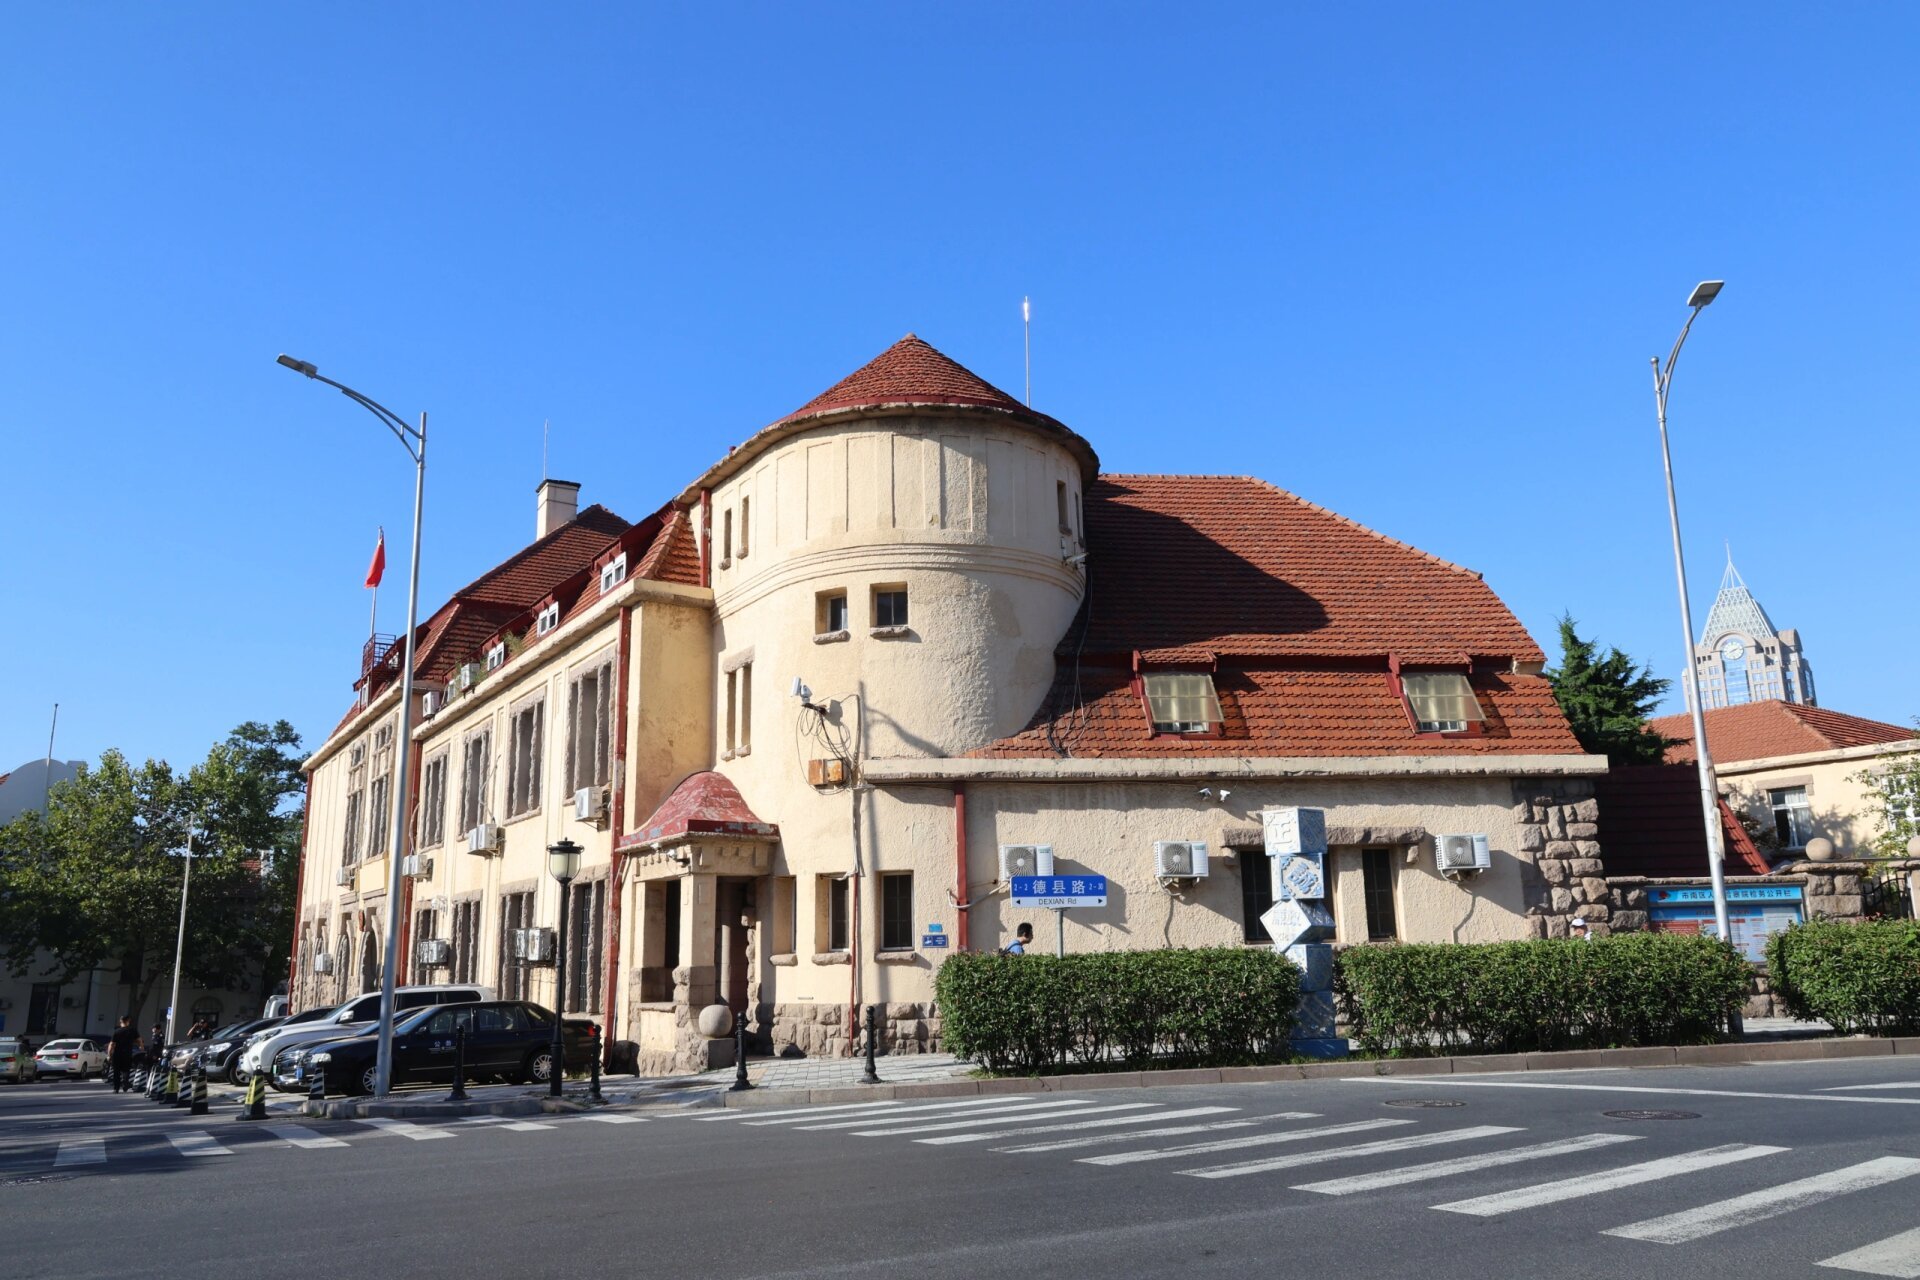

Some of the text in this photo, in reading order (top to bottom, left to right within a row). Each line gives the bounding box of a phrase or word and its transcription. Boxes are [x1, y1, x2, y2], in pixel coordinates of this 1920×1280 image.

[1014, 884, 1028, 892] 2-2
[1032, 880, 1086, 894] 德县路
[1681, 889, 1792, 900] 市南区人检察院检务公开栏
[1067, 897, 1077, 905] Rd
